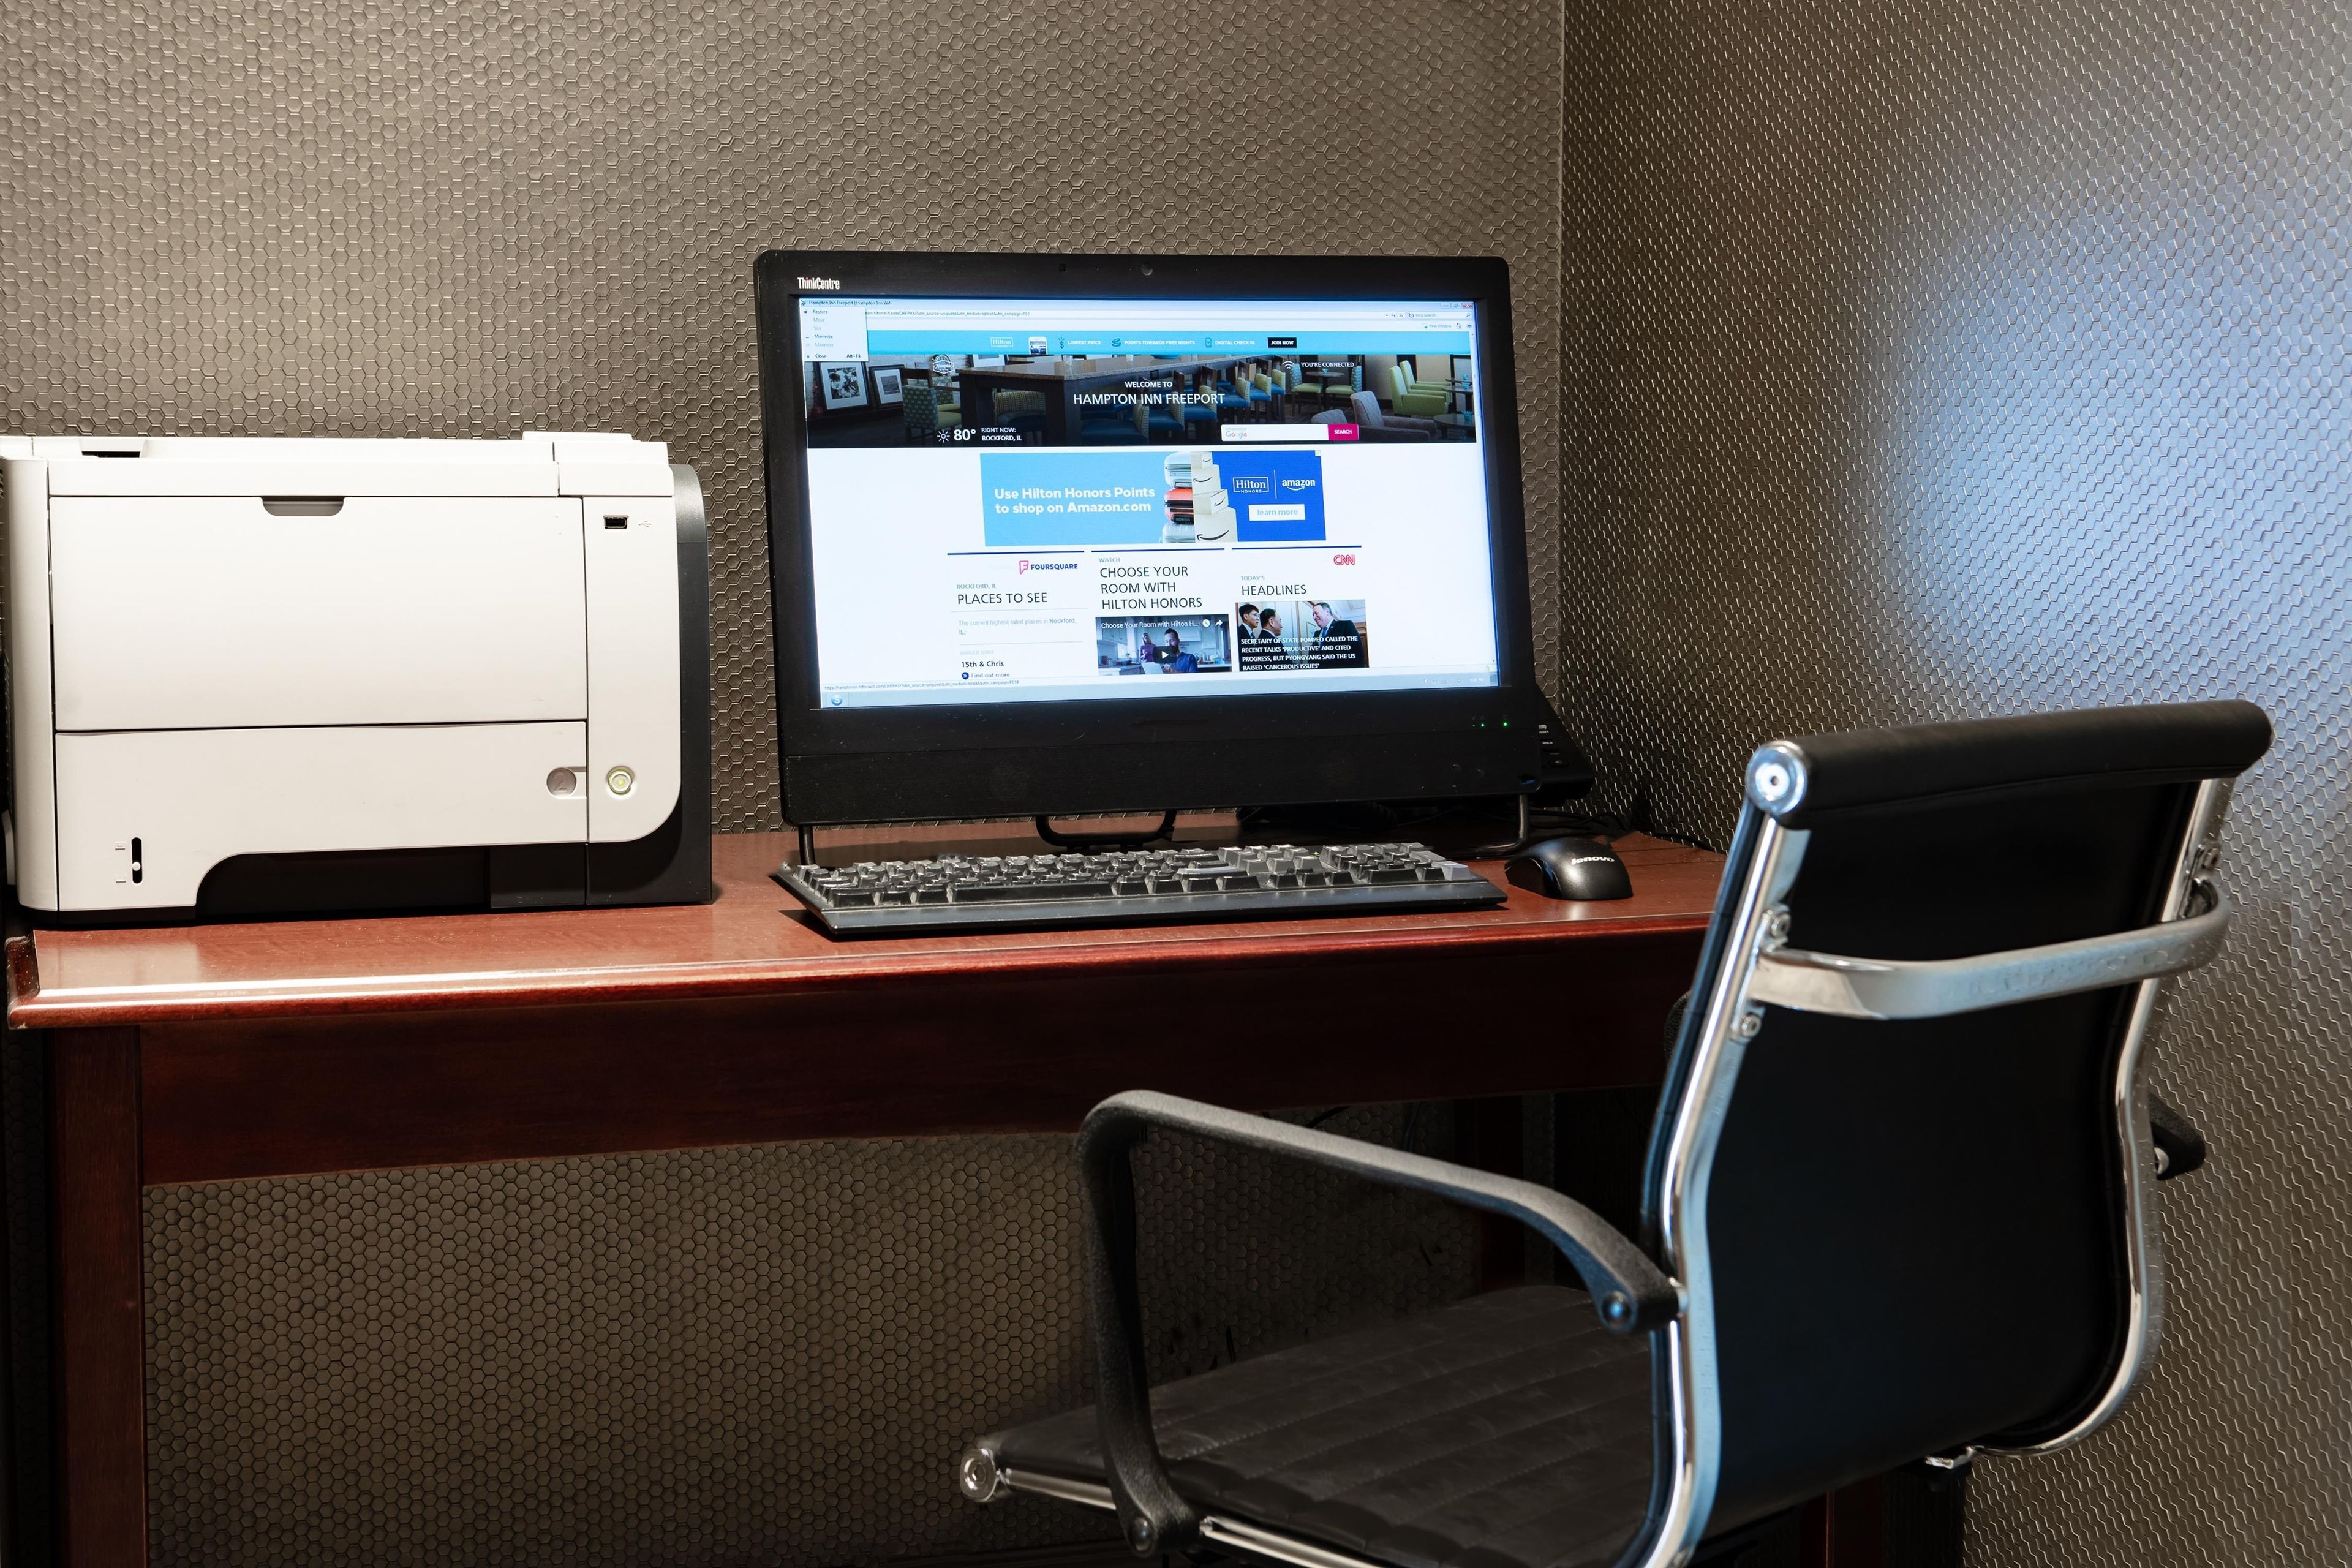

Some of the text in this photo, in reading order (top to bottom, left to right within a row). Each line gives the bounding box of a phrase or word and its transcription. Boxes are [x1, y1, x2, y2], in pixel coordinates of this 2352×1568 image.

[797, 277, 840, 290] ThinkCentre
[1074, 393, 1225, 404] HAMPTON INN FREEPORT
[953, 429, 976, 441] 80°
[1236, 480, 1266, 489] Hilton
[995, 487, 1155, 499] Use Hilton Honors Points
[995, 502, 1152, 515] to shop on Amazon.com
[1333, 554, 1355, 566] CNN
[1100, 566, 1188, 578] CHOOSE YOUR
[1101, 582, 1176, 594] ROOM WITH
[1242, 584, 1307, 596] HEADLINES
[958, 592, 1047, 605] PLACES TO SEE
[1102, 597, 1202, 609] HILTON HONORS
[552, 771, 568, 793] 2
[1571, 856, 1615, 865] lenovo
